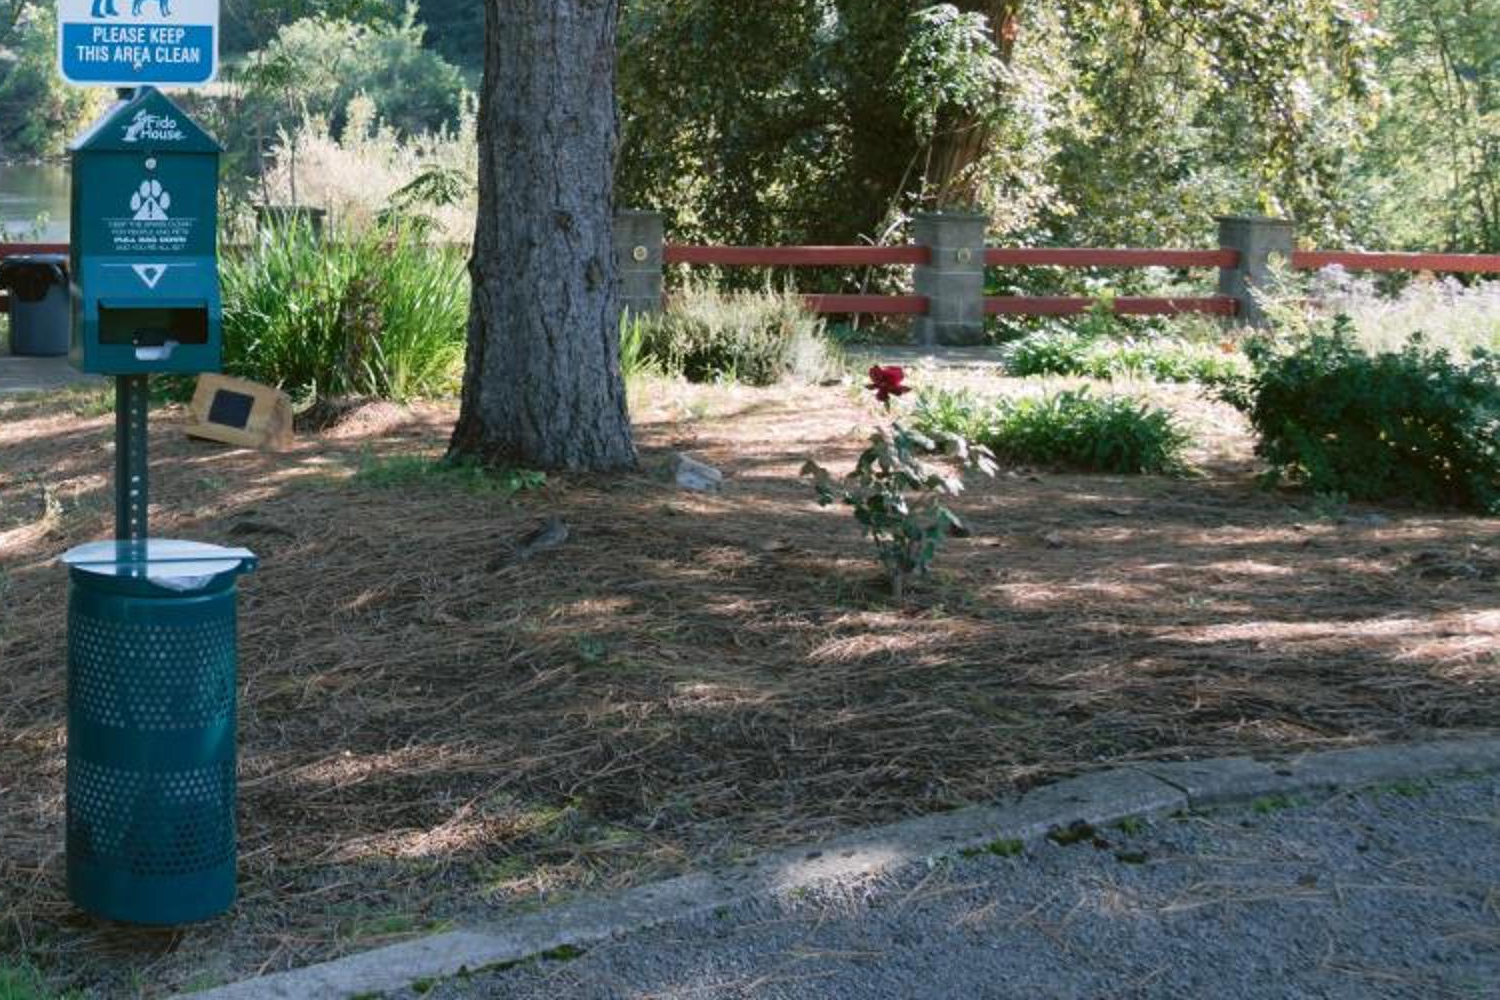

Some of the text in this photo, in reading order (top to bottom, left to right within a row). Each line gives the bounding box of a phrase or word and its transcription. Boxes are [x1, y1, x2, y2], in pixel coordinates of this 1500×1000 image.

[93, 27, 185, 44] PLEASE KEEP
[77, 45, 200, 63] THIS AREA CLEAN
[147, 114, 177, 129] Fido
[139, 127, 187, 141] House
